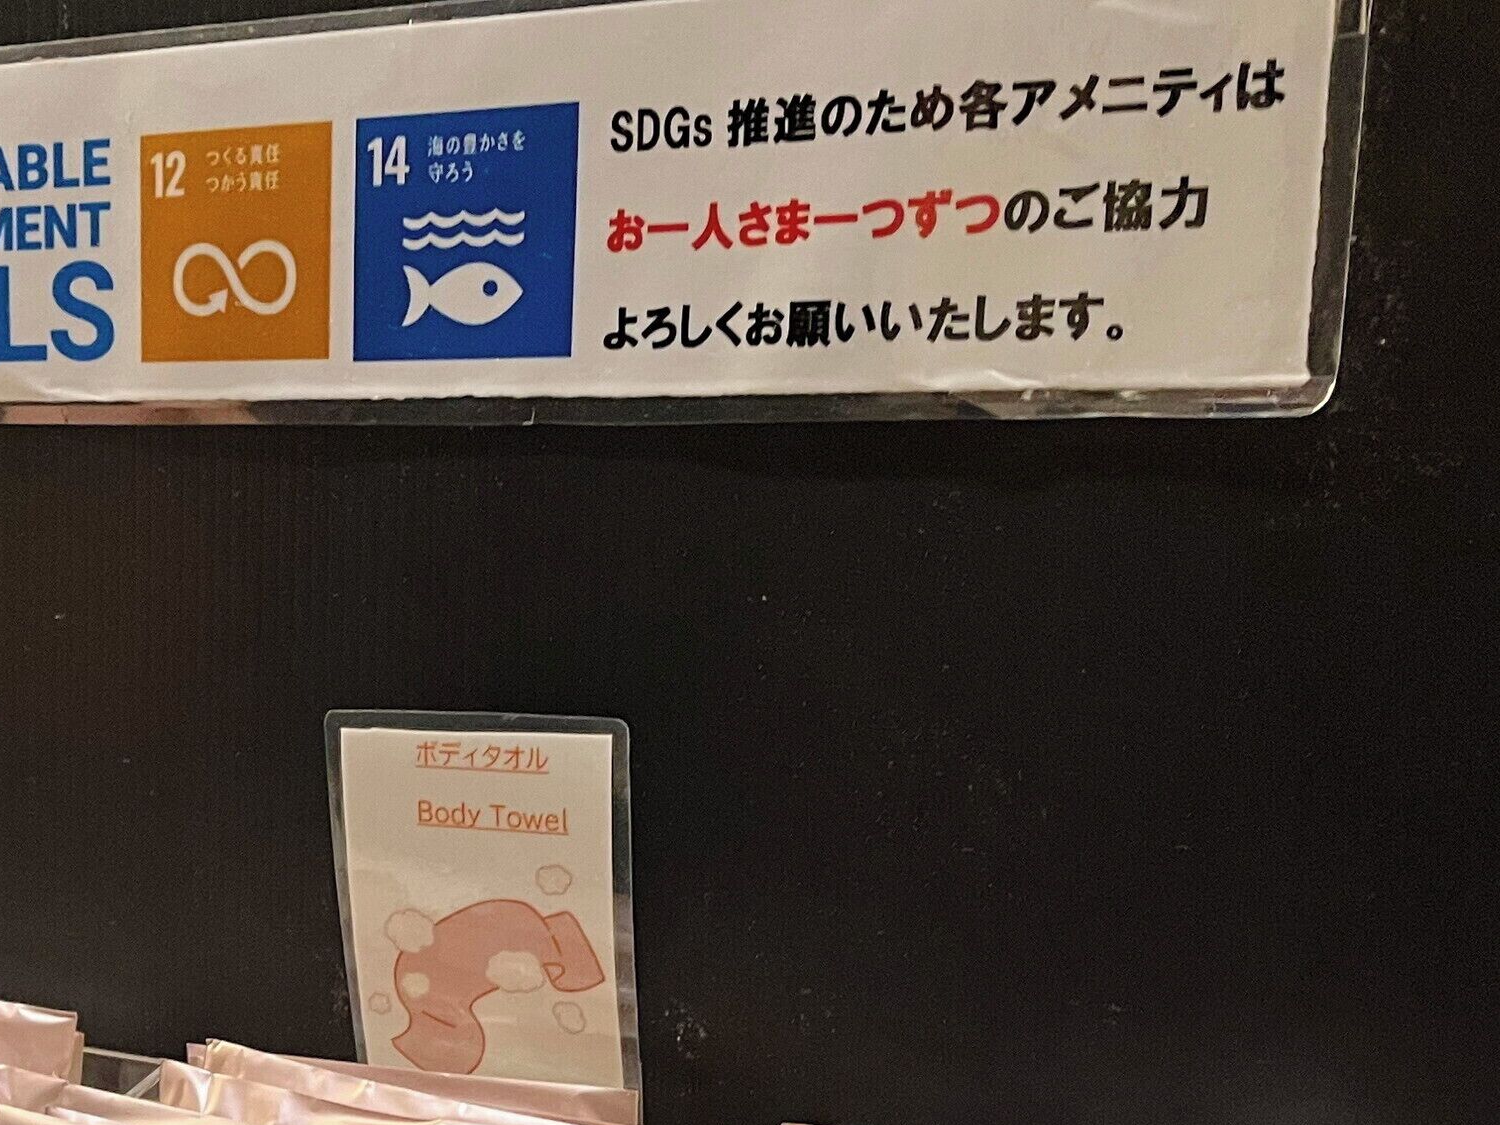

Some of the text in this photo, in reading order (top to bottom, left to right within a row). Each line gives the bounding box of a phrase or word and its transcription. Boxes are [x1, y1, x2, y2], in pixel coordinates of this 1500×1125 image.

[610, 58, 1286, 152] SDGs 推進のため各アメニティは
[205, 143, 281, 166] つくる責任
[367, 135, 410, 187] 14
[427, 130, 526, 159] 海の豊かさを
[150, 150, 187, 199] 12
[205, 170, 281, 193] つかう責任
[428, 160, 474, 184] 守ろう
[605, 175, 1210, 253] お一人さま一つずつのご協力
[602, 290, 1125, 350] よろしくお願いいたします。
[415, 741, 550, 771] ボディタオル
[417, 800, 569, 834] Body Towel
